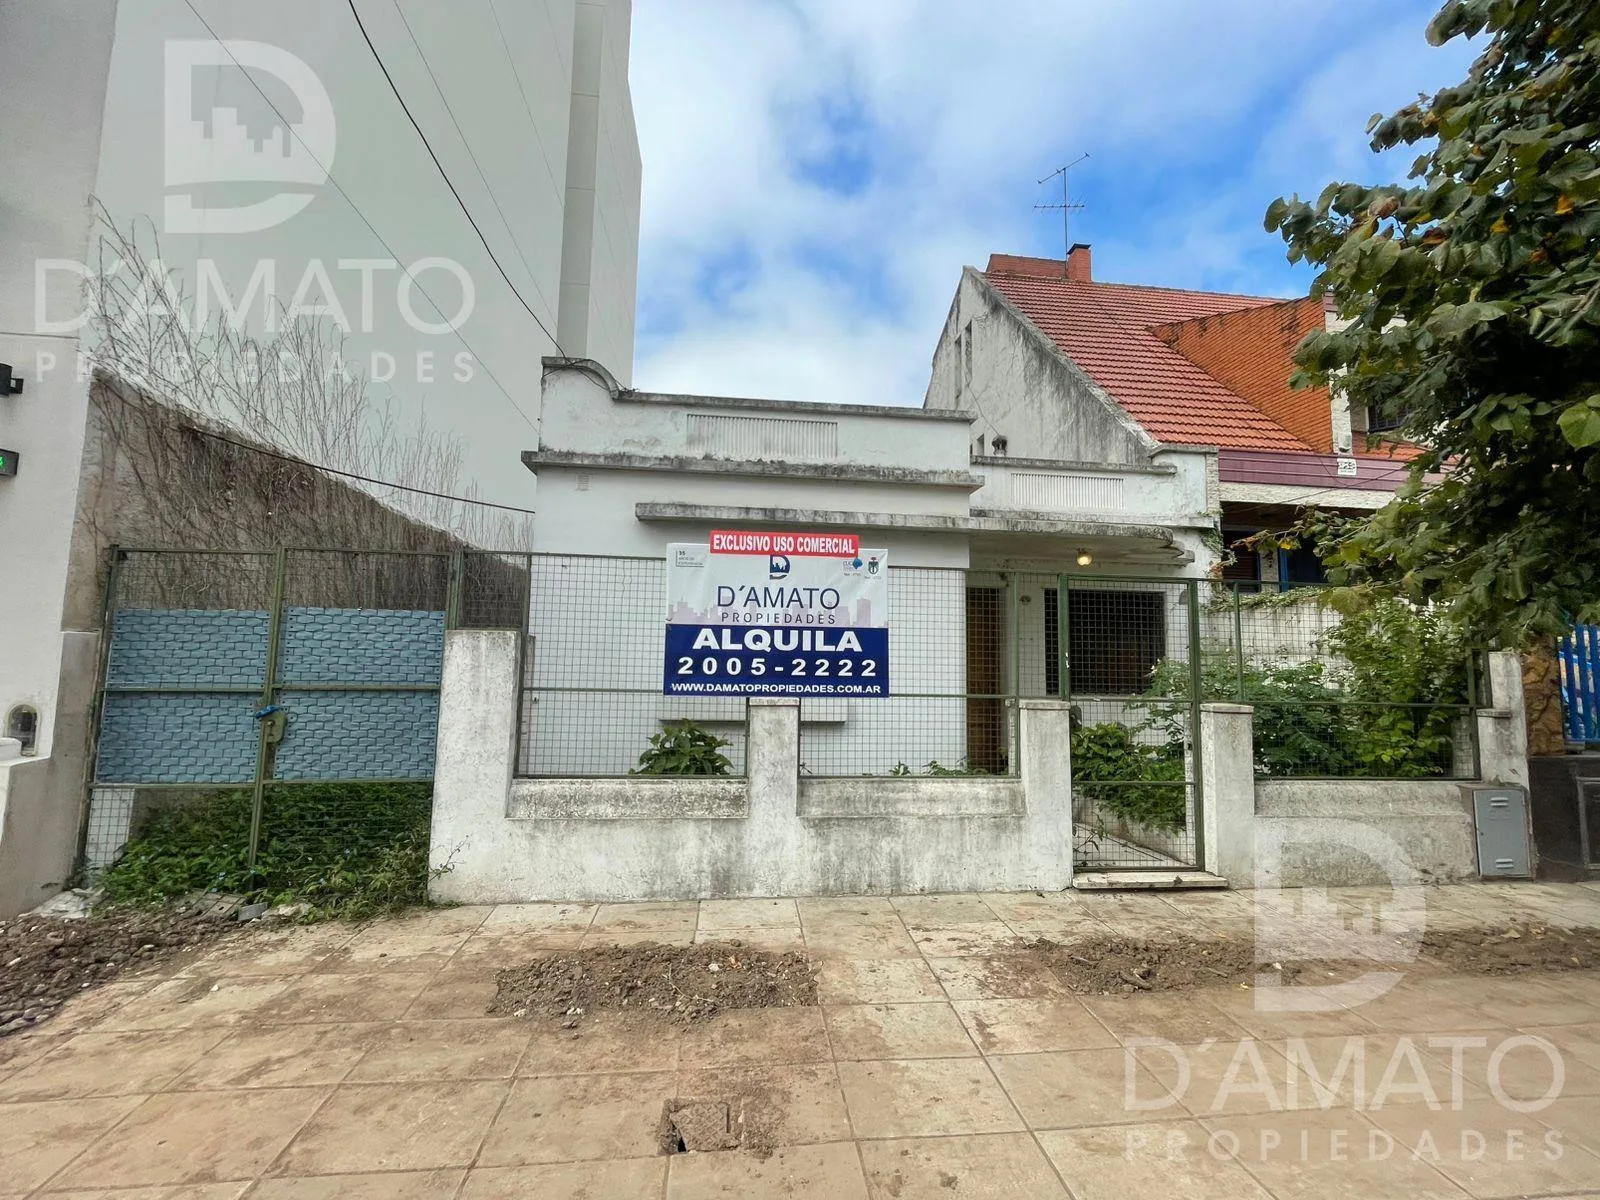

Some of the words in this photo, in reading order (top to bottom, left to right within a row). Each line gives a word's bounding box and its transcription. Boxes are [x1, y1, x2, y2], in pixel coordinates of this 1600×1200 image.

[713, 534, 771, 552] EXCLUSIVO
[773, 536, 795, 552] USO
[797, 537, 856, 554] COMERCIAL
[721, 612, 836, 625] PROPIEDADES
[692, 628, 863, 652] ALQUILA
[671, 683, 881, 694] WWW.DAMATOPROPIEDADES.COM.AR
